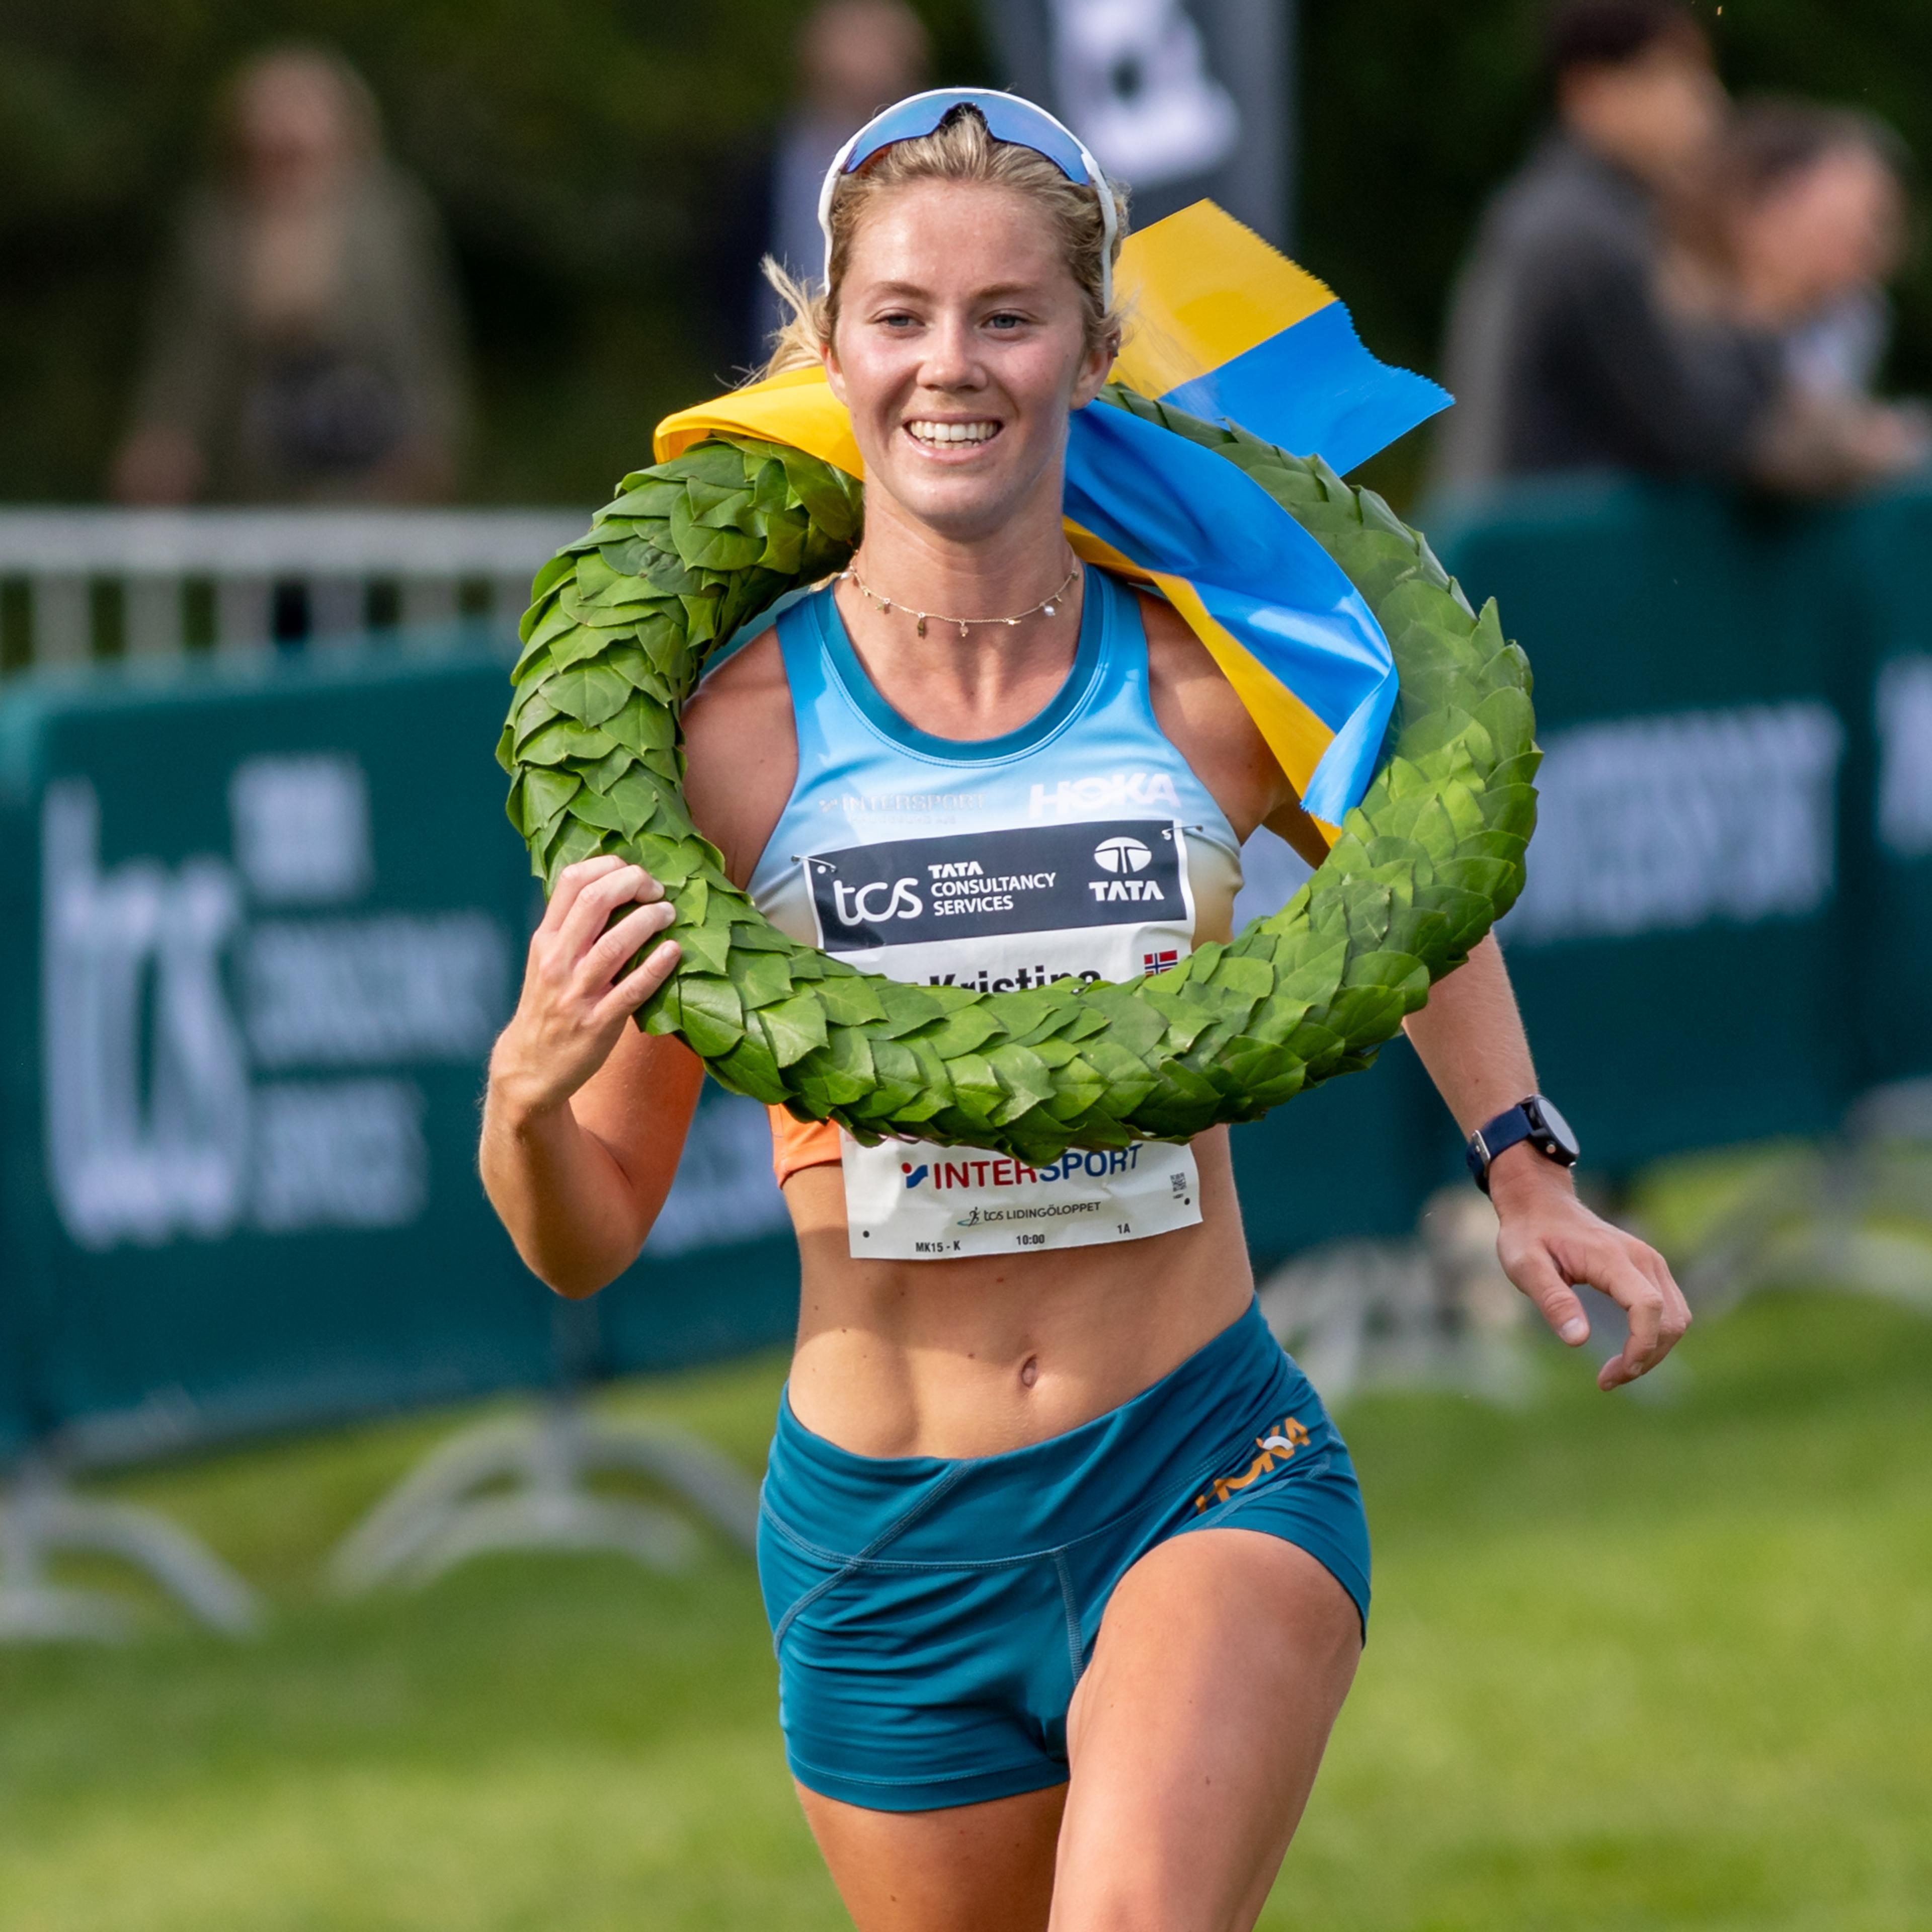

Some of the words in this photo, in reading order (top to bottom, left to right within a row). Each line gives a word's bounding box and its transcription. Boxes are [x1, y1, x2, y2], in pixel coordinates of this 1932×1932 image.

[841, 793, 987, 812] INTERSPORT
[1029, 773, 1180, 820] HOKA
[928, 861, 984, 879] TATA
[931, 872, 1056, 897] CONSULTANCY
[1088, 880, 1165, 901] TATA
[833, 877, 923, 926] tcs
[933, 895, 1014, 916] SERVICES
[934, 1144, 1143, 1189] INTERSPORT
[1007, 1201, 1101, 1220] LIDINGÖLOPPET
[1117, 1223, 1131, 1234] 1A
[916, 1241, 944, 1252] MK15
[954, 1240, 961, 1251] K
[1016, 1234, 1045, 1245] 10:00
